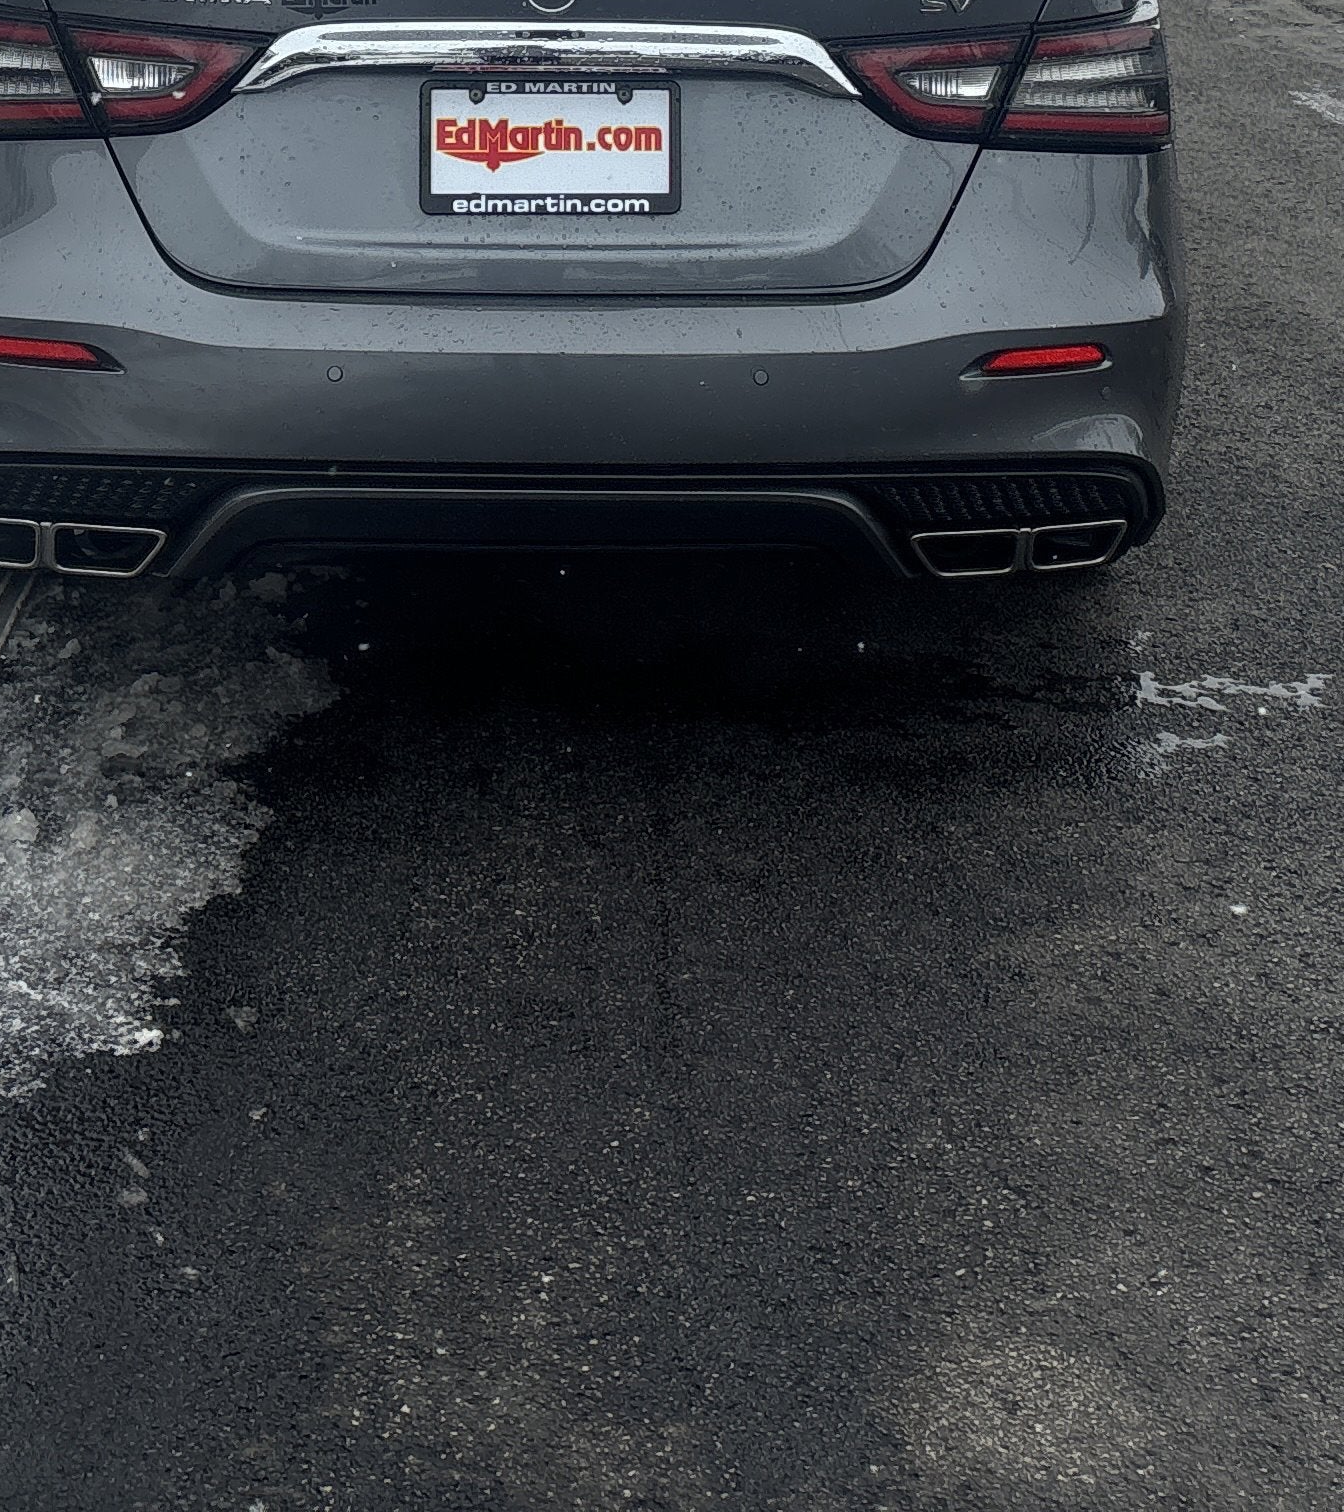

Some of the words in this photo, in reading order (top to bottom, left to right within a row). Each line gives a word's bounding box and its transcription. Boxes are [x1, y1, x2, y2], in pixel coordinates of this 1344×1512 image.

[486, 82, 522, 93] ED
[525, 82, 616, 93] MARTIN
[452, 194, 650, 213] edmartin.com
